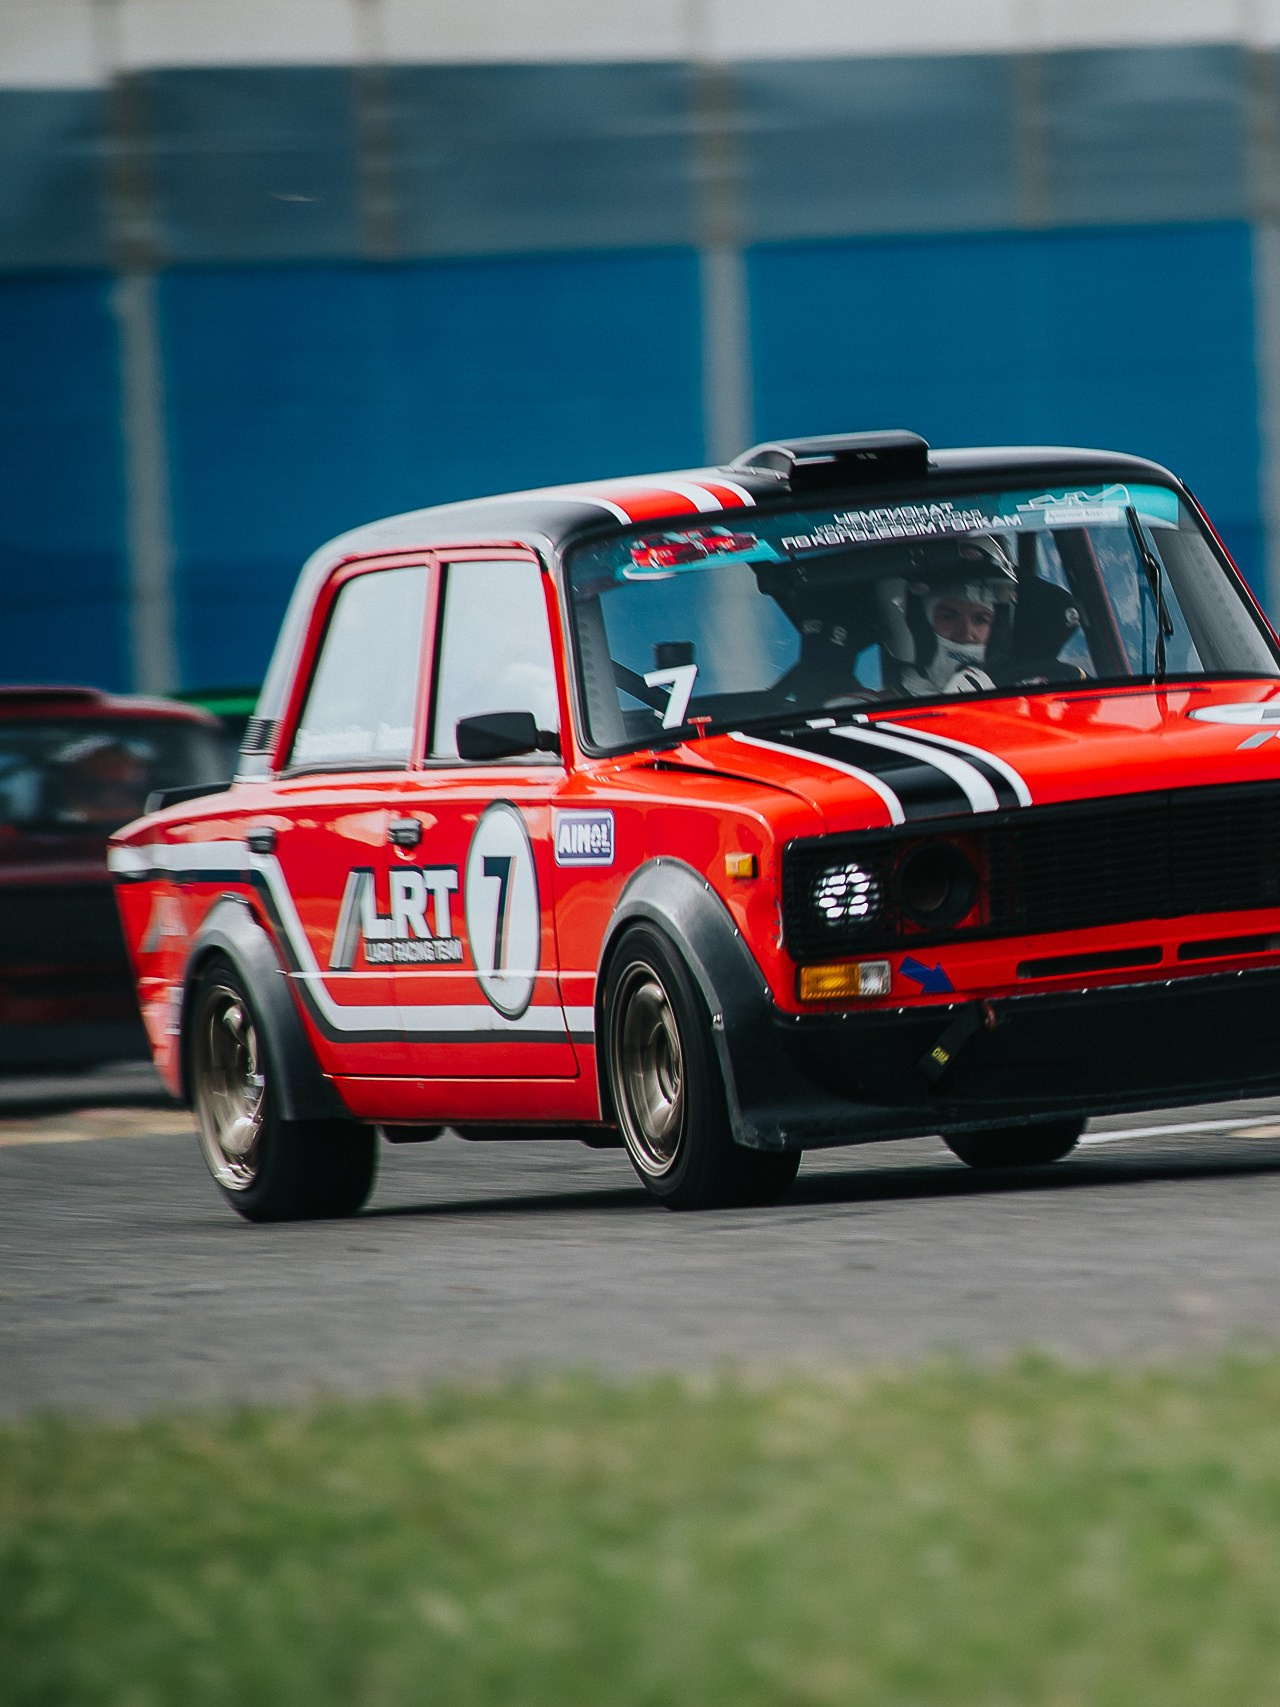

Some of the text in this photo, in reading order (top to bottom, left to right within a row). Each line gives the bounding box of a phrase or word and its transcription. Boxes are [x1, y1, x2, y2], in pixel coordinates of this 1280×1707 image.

[781, 513, 1022, 549] ПО КОЛЬЦЕВЫМ ГОНКАМ
[834, 502, 954, 525] ЧЕМПИОНАТ
[643, 664, 698, 730] 7
[482, 855, 518, 979] 7
